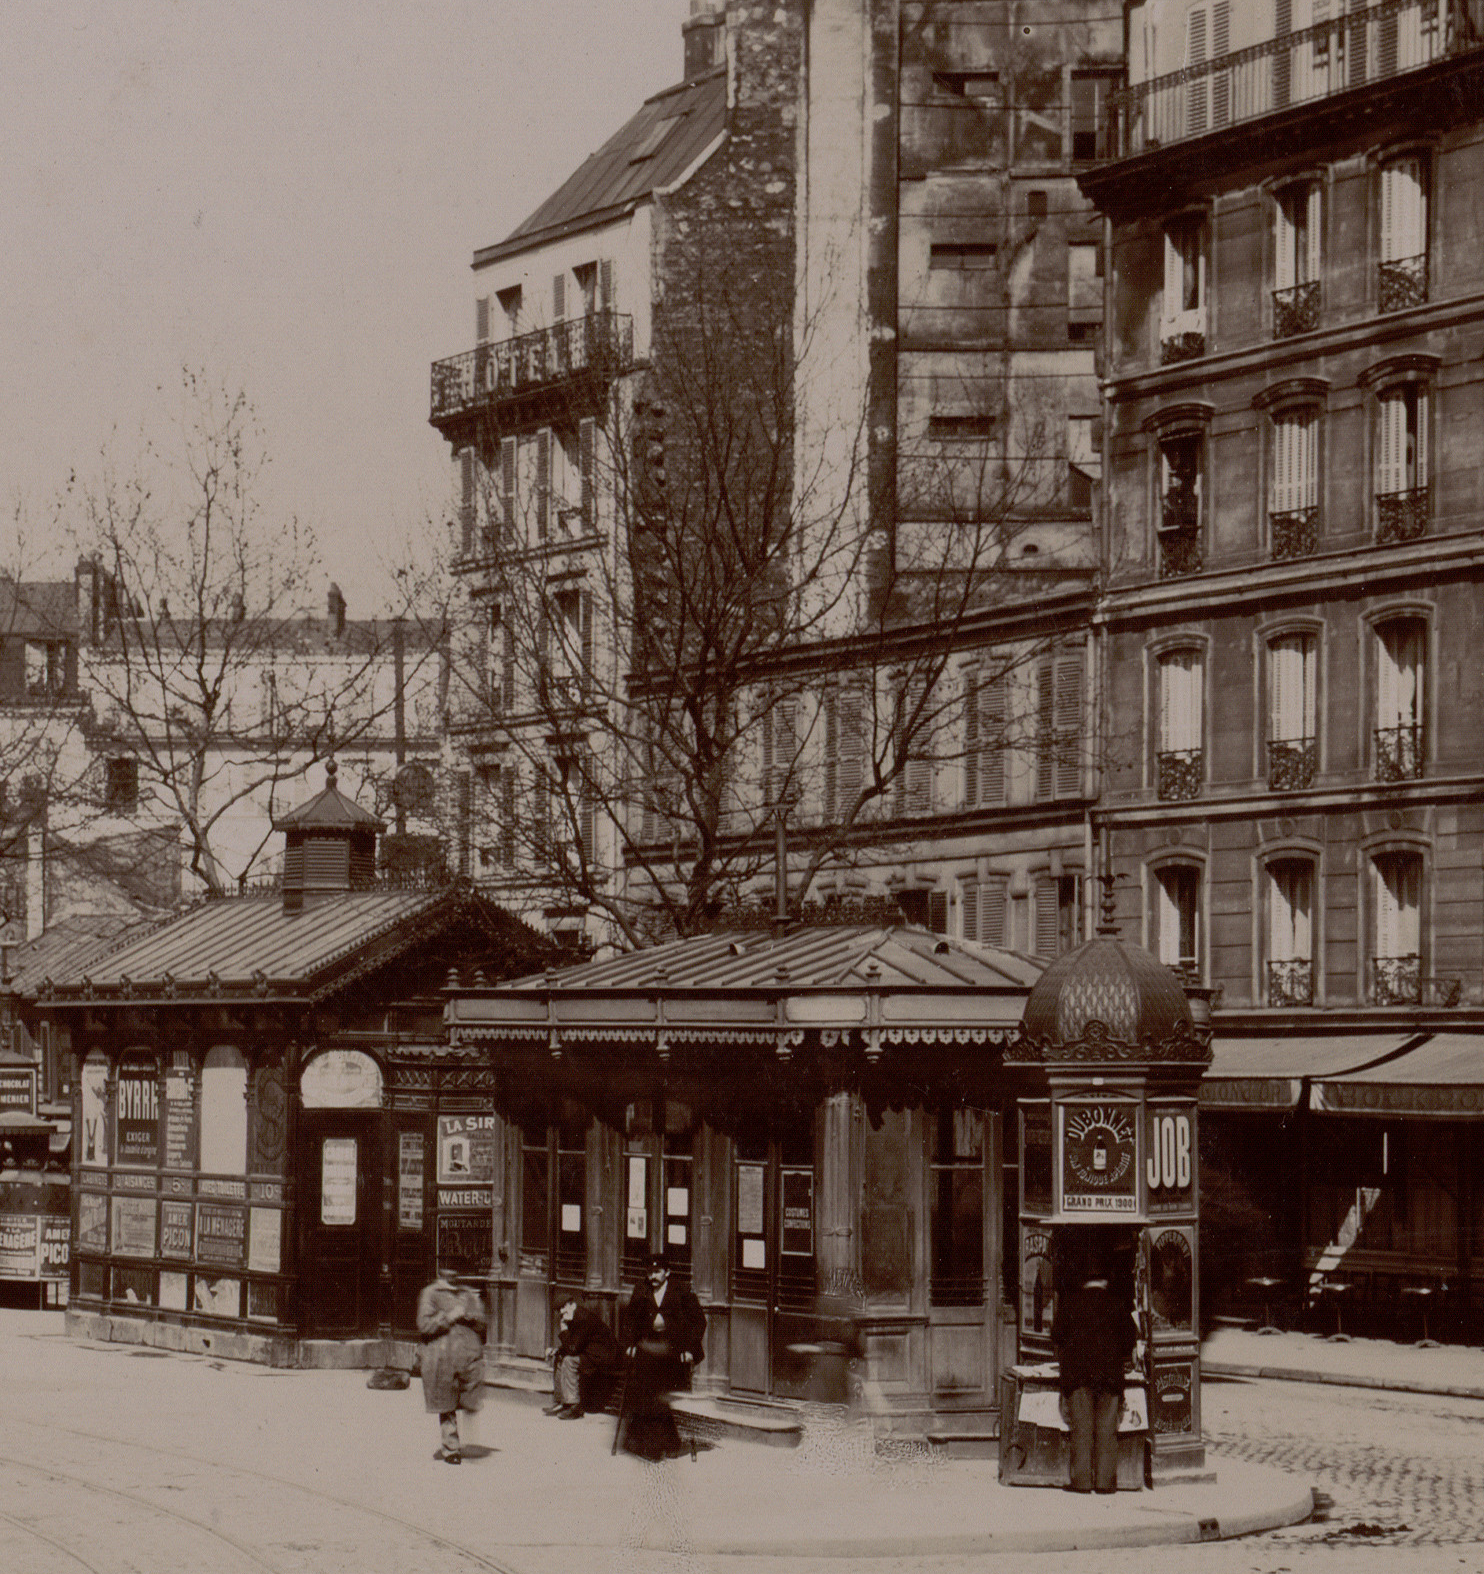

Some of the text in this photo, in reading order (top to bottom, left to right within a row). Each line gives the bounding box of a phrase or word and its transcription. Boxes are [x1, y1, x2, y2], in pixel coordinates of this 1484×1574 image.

[0, 1094, 30, 1104] MENIER
[446, 1119, 463, 1134] LA
[1066, 1105, 1136, 1145] DUBONNET
[126, 1132, 150, 1142] EXIGER
[1146, 1115, 1191, 1189] JOB
[1066, 1196, 1093, 1207] GRAND
[1095, 1196, 1113, 1207] PRIX
[1115, 1196, 1133, 1208] 1900
[167, 1213, 189, 1227] AMER
[163, 1227, 191, 1249] PICON
[40, 1242, 70, 1265] PICO
